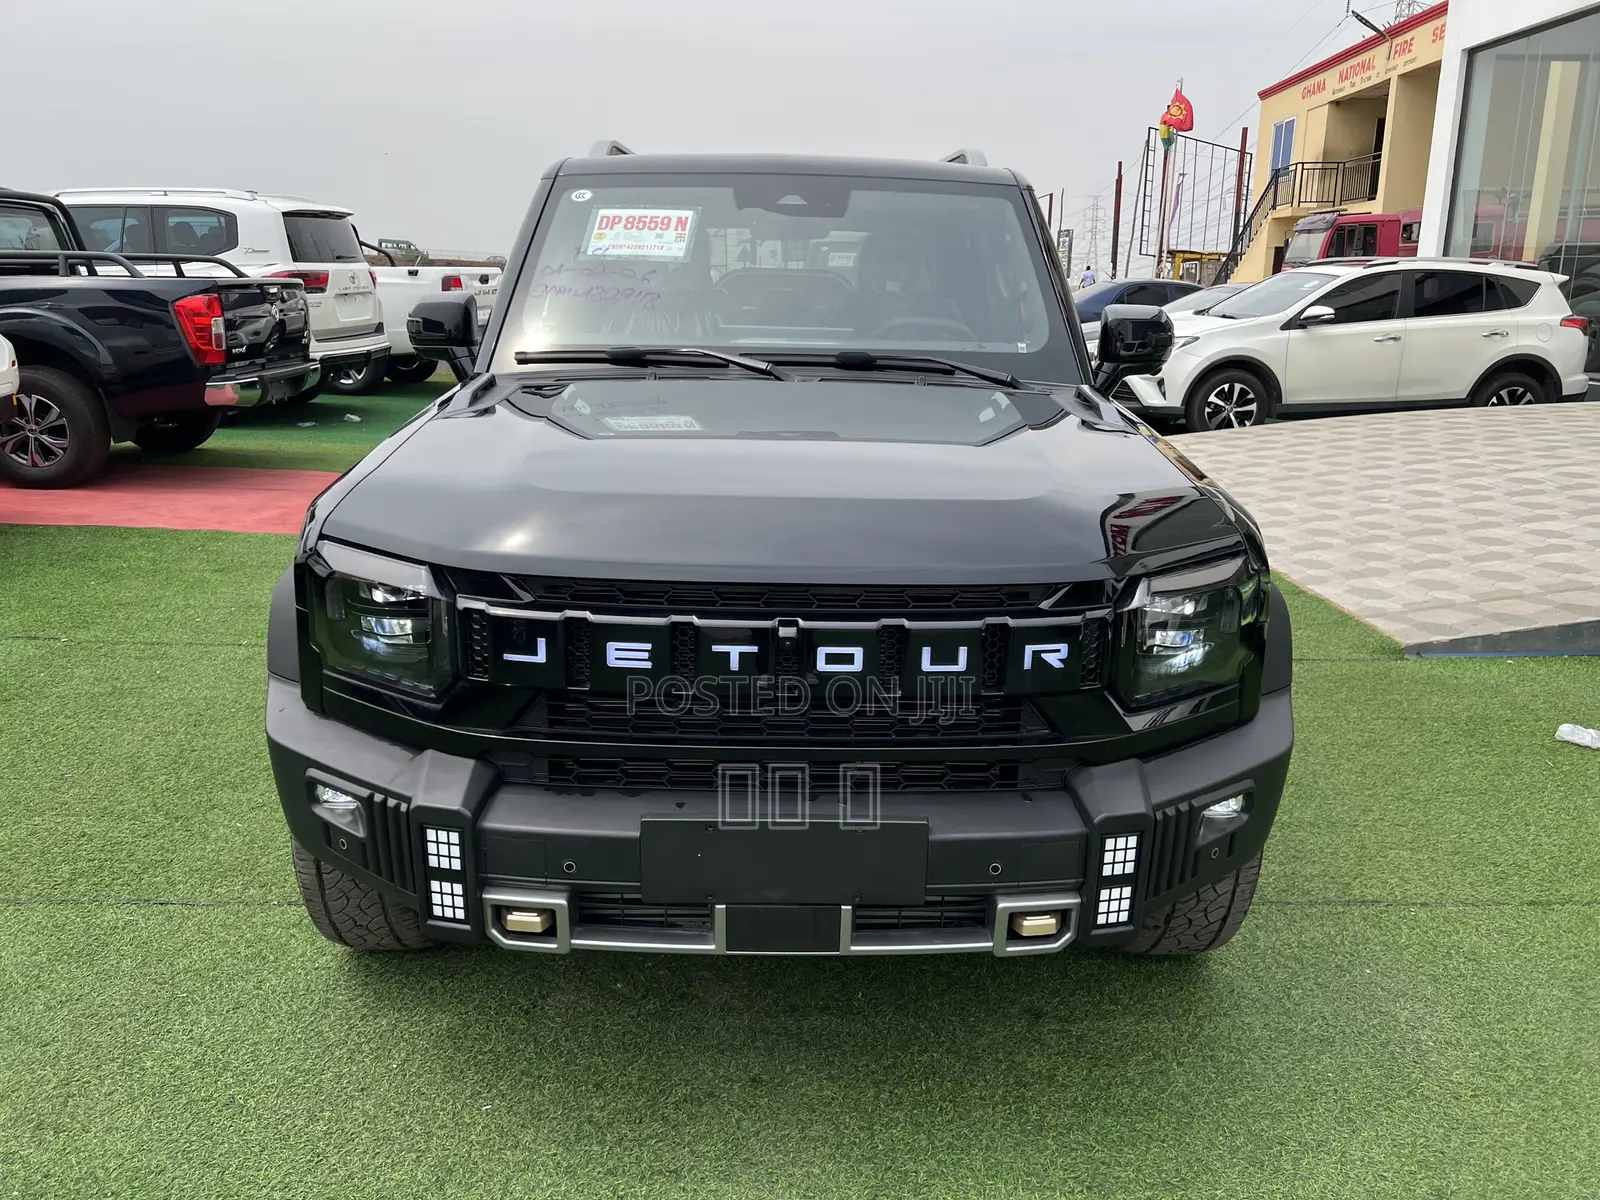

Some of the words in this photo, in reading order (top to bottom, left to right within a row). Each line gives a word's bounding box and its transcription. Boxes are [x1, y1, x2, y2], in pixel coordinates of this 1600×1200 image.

[1301, 77, 1327, 100] GHANA
[1337, 54, 1377, 85] NATIONAL
[1392, 36, 1416, 60] FIRE
[597, 215, 623, 231] DP
[623, 215, 673, 231] 8559
[674, 216, 689, 232] N
[502, 637, 1069, 673] JETOUR
